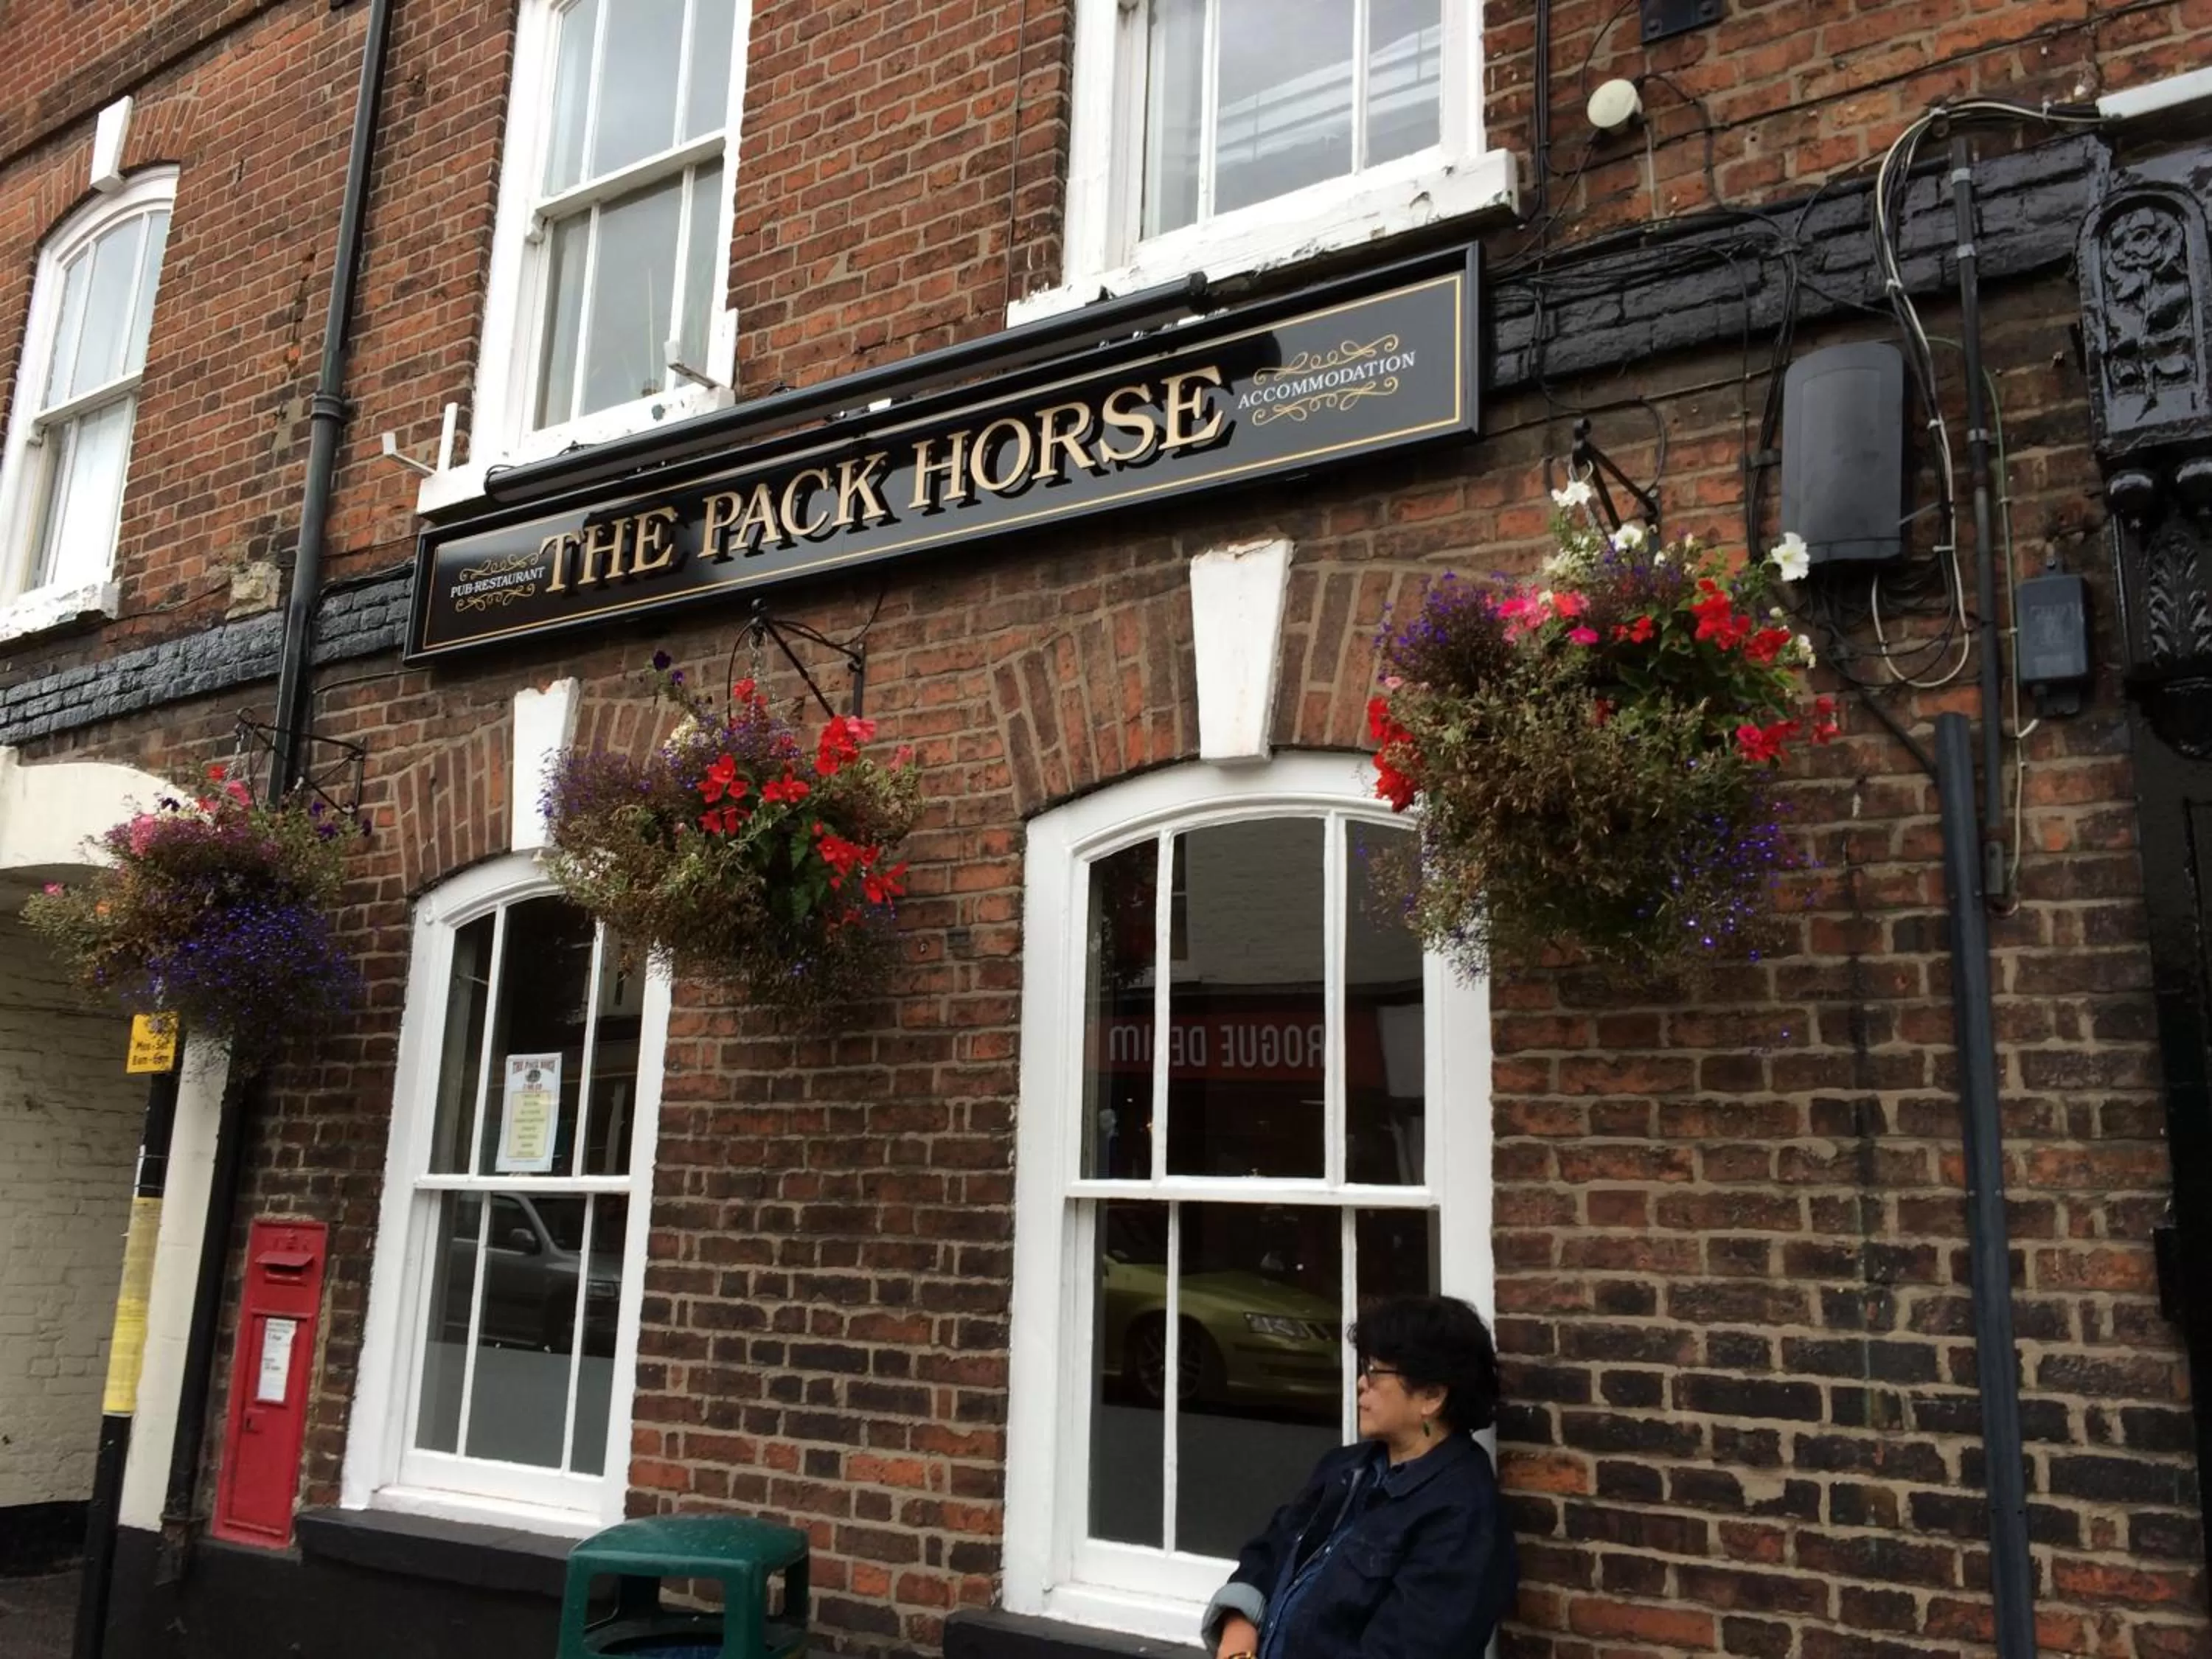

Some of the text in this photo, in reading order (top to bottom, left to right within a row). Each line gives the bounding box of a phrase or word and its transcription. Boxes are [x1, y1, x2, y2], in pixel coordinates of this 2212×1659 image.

[1238, 350, 1416, 408] ACCOMMODATION
[539, 366, 1223, 592] THE PACK HORSE
